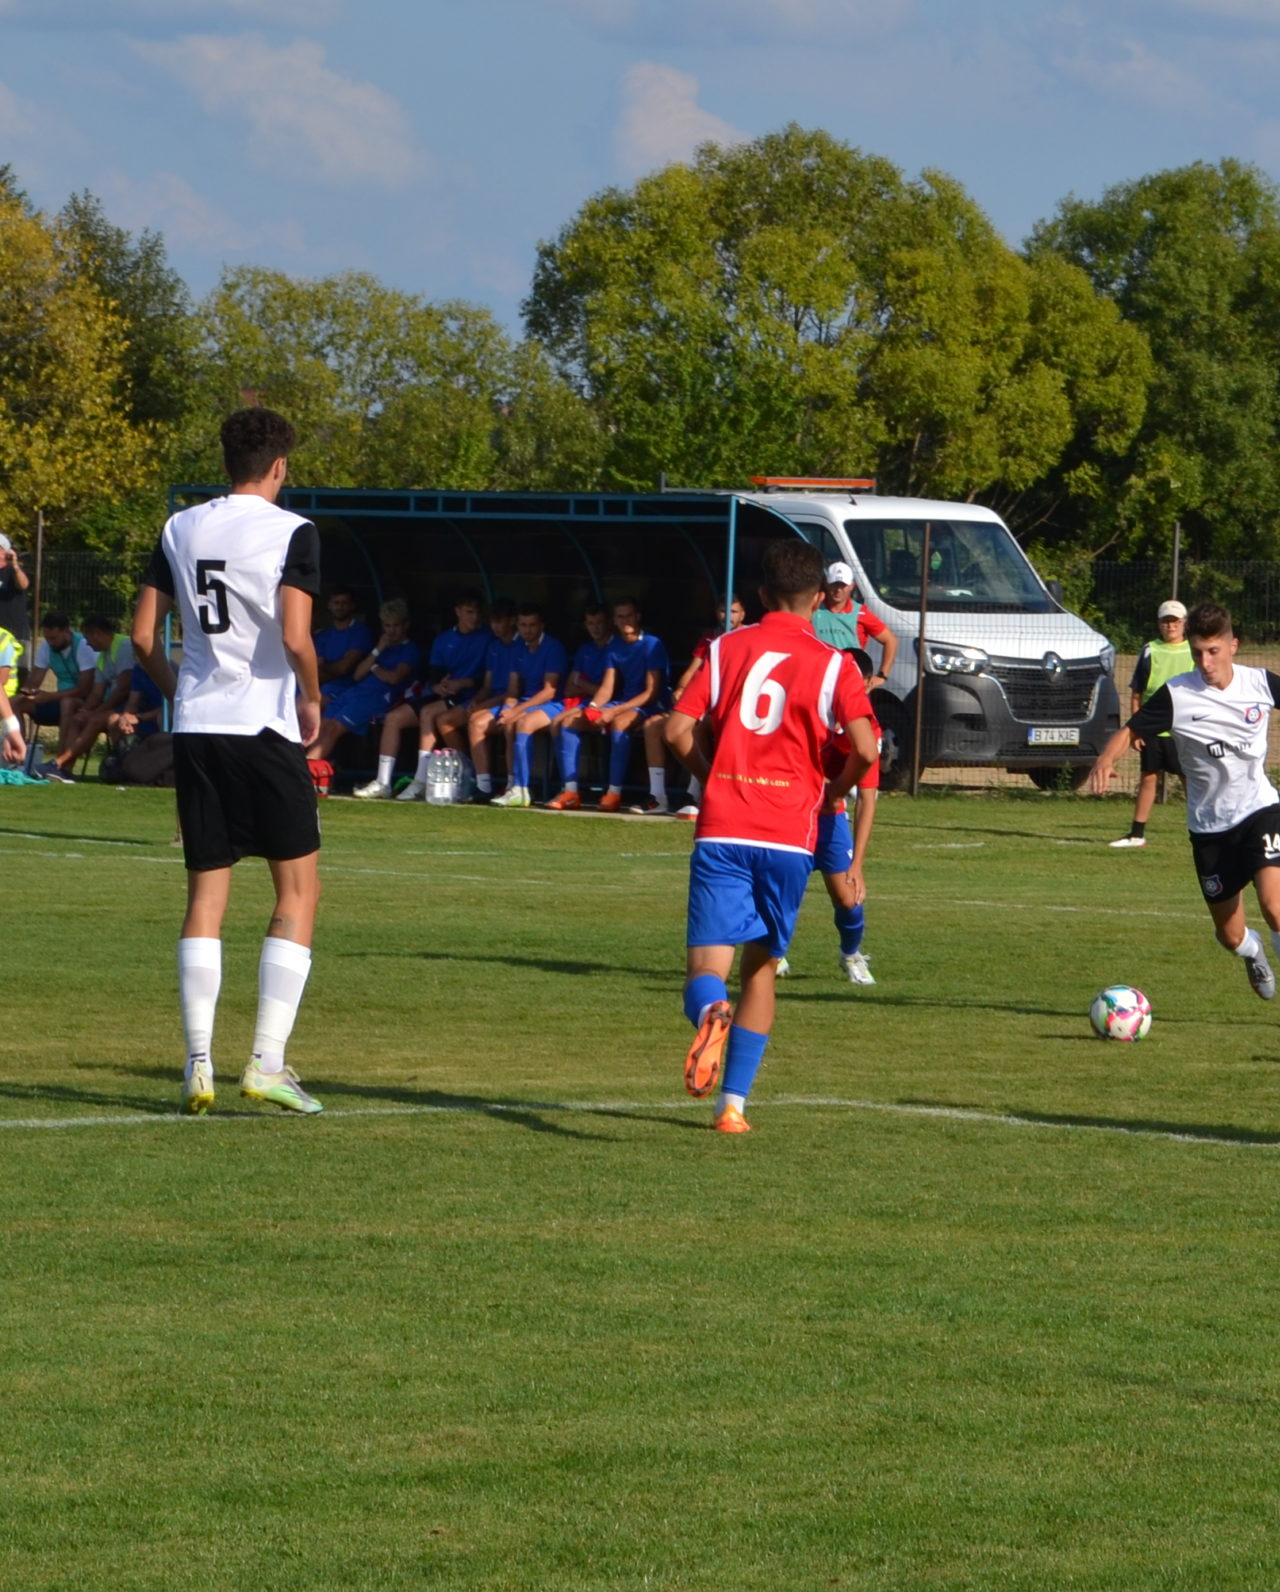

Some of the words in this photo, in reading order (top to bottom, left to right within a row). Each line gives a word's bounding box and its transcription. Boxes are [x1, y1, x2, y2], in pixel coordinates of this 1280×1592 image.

[196, 559, 231, 635] 5
[739, 650, 793, 736] 6
[1034, 730, 1042, 741] B
